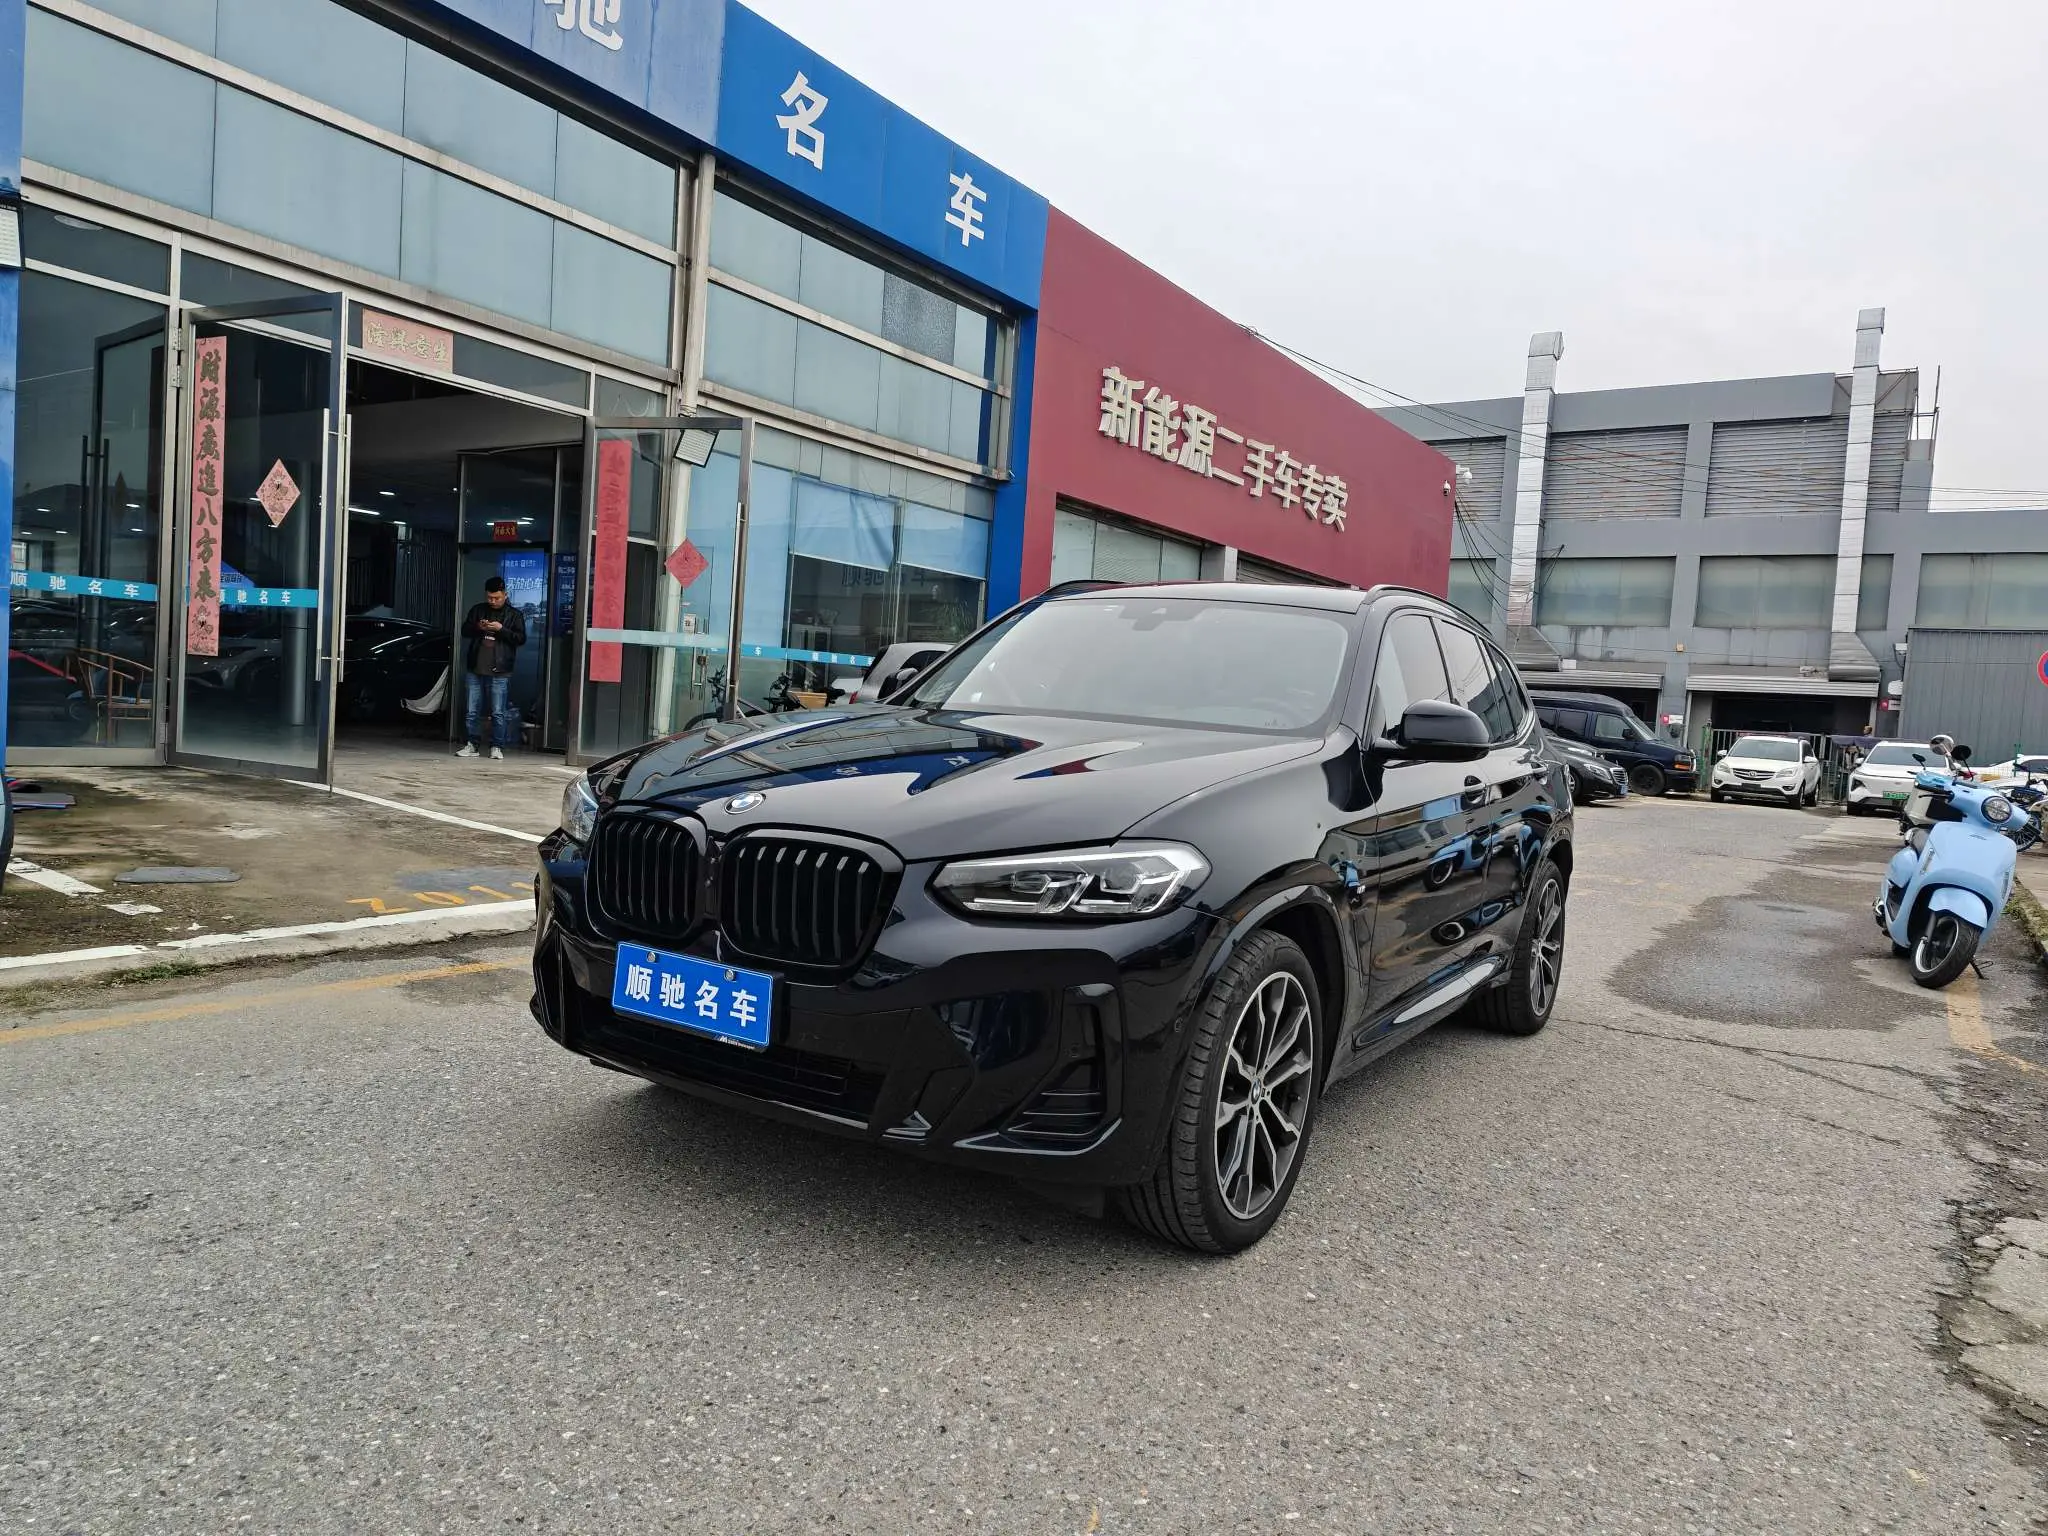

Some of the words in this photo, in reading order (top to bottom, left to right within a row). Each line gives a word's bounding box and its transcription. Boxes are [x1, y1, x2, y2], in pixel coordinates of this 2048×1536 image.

[1099, 366, 1348, 532] 新能源二手车专卖
[10, 571, 140, 598] 顺驰名车
[625, 964, 757, 1027] 顺驰名车
